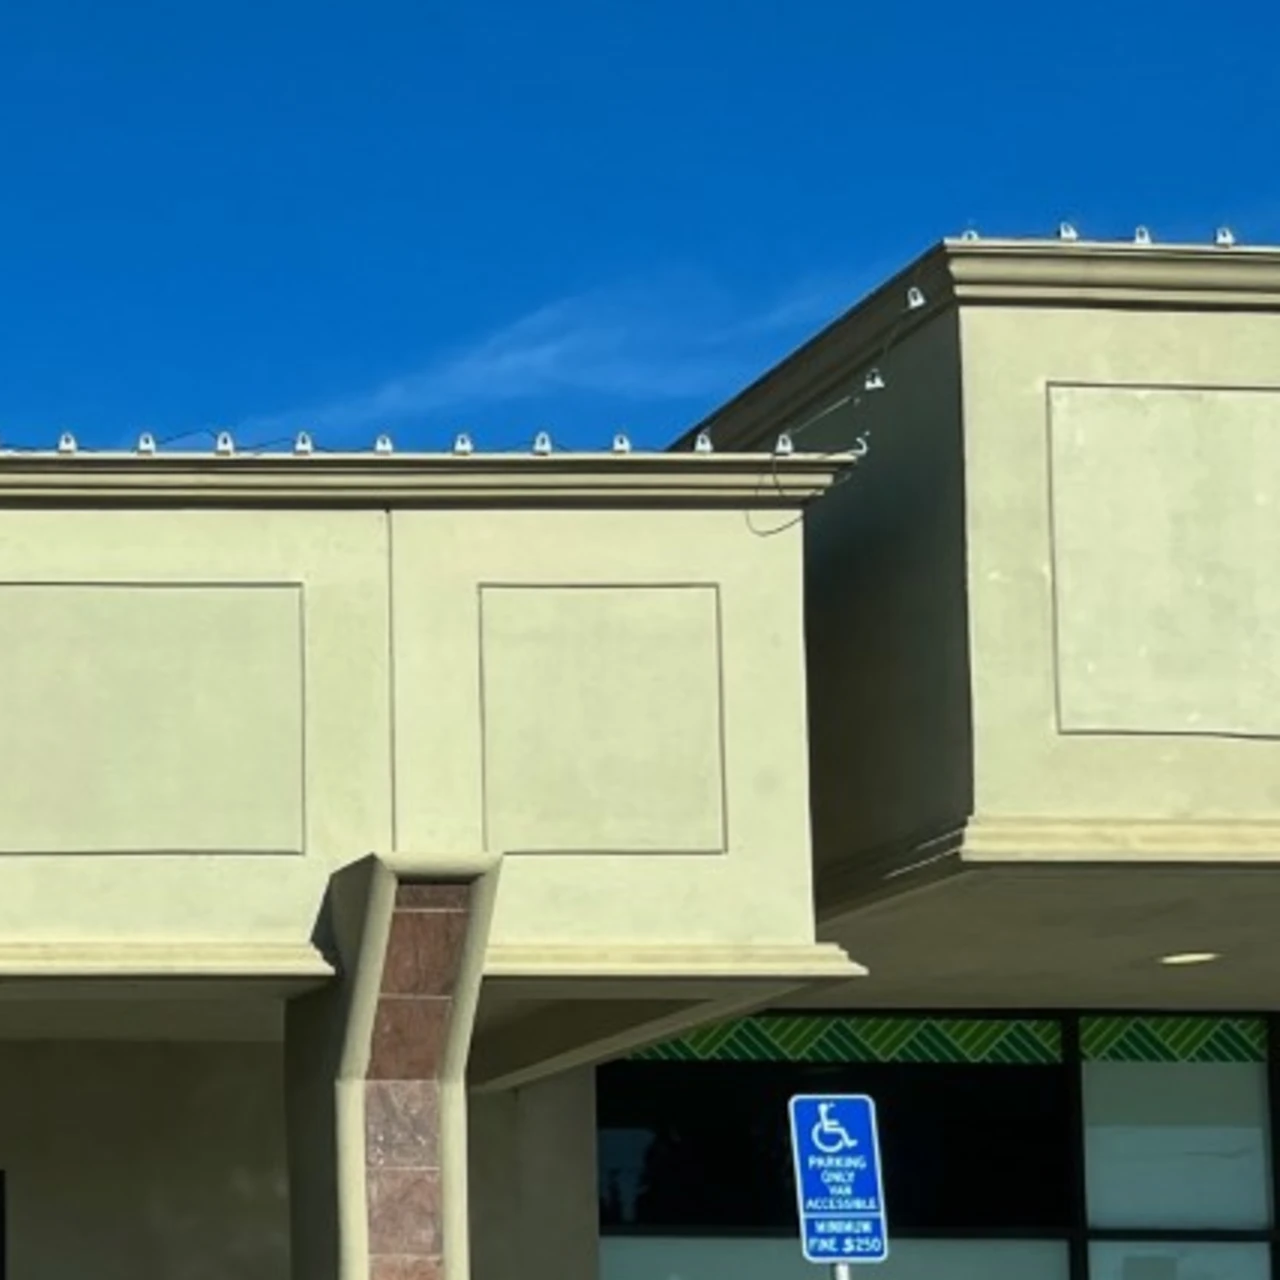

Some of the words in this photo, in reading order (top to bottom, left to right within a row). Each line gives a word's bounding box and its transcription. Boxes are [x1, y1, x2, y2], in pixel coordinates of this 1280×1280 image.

[807, 1155, 868, 1170] PARKING
[820, 1170, 855, 1184] ONLY
[829, 1184, 853, 1196] VAN
[806, 1198, 879, 1211] ACCESSIBLE
[815, 1220, 874, 1234] MINIMUM
[808, 1238, 838, 1252] FINE
[842, 1237, 882, 1254] $250
